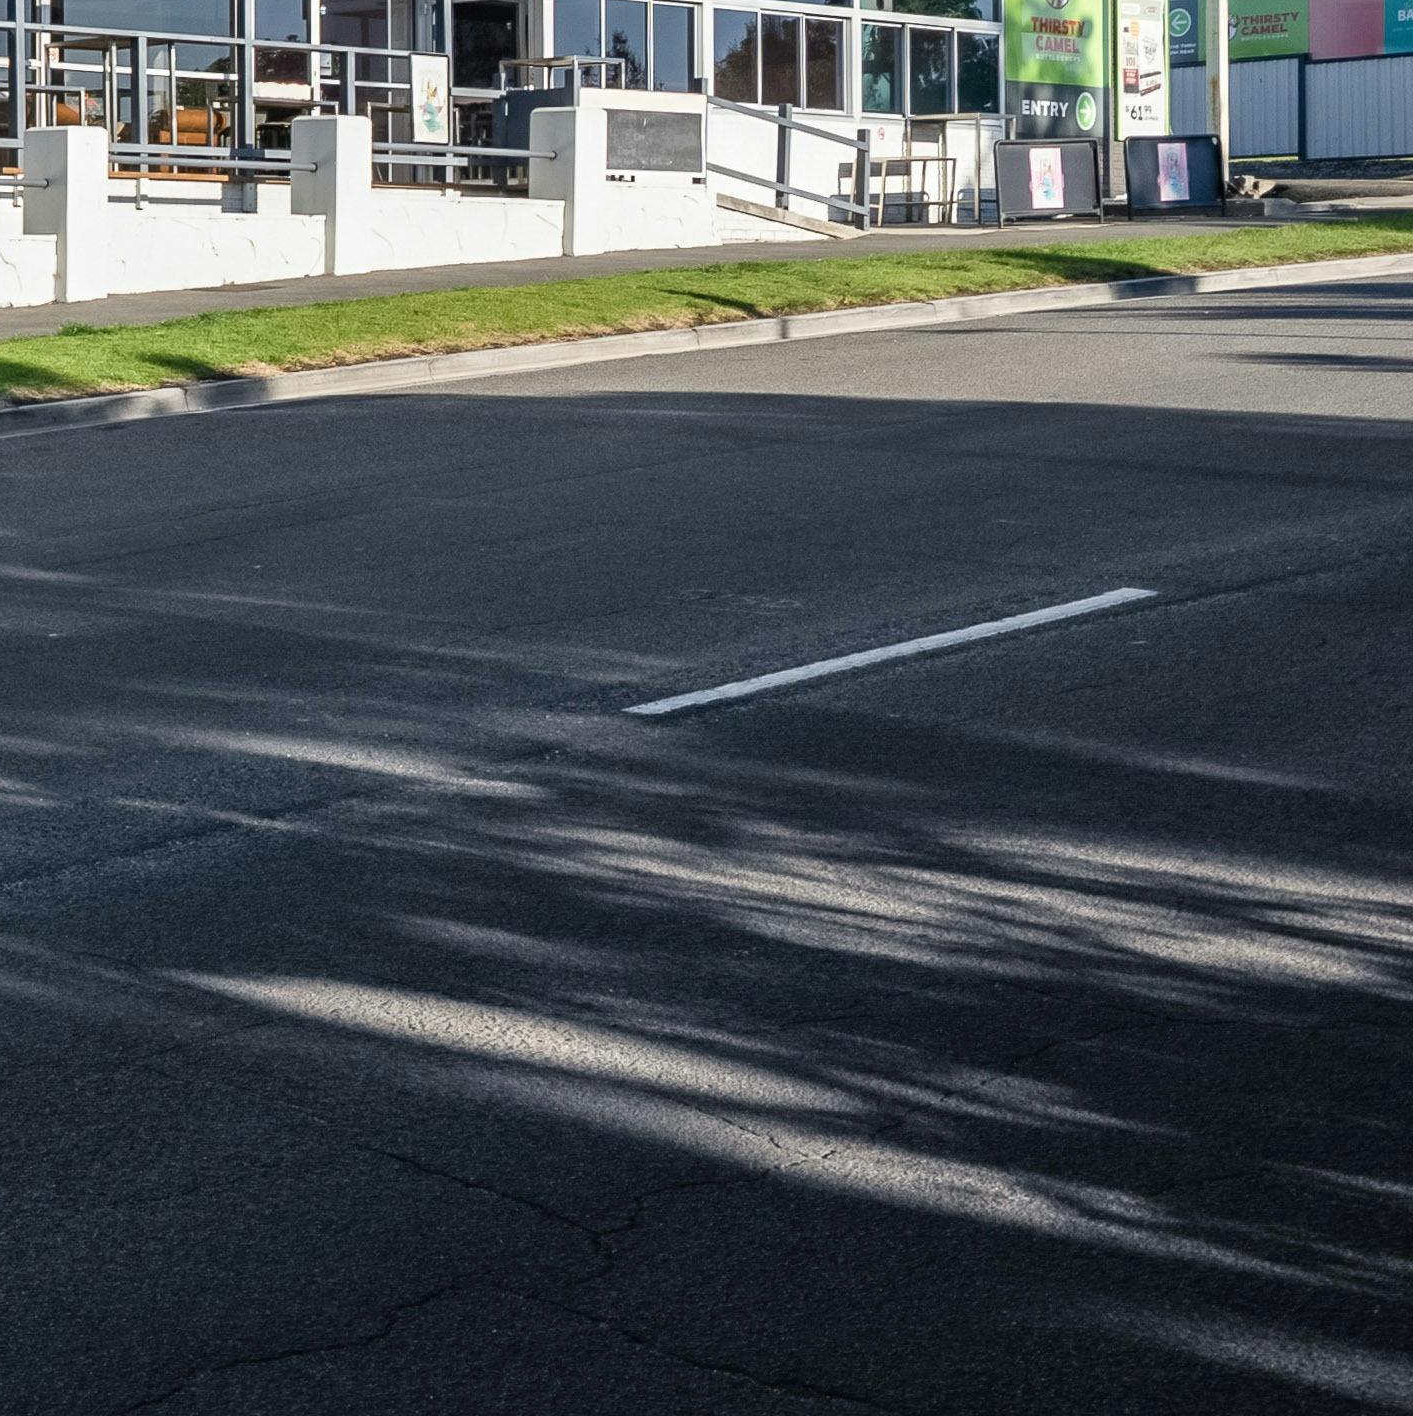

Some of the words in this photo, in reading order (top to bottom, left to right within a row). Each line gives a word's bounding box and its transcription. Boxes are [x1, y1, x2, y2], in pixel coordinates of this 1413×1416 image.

[1031, 16, 1086, 38] THIRSTY
[1241, 11, 1299, 25] THIRSTY
[1241, 24, 1288, 36] CAMEL
[1035, 35, 1080, 54] CAMEL
[1021, 99, 1069, 118] ENTRY
